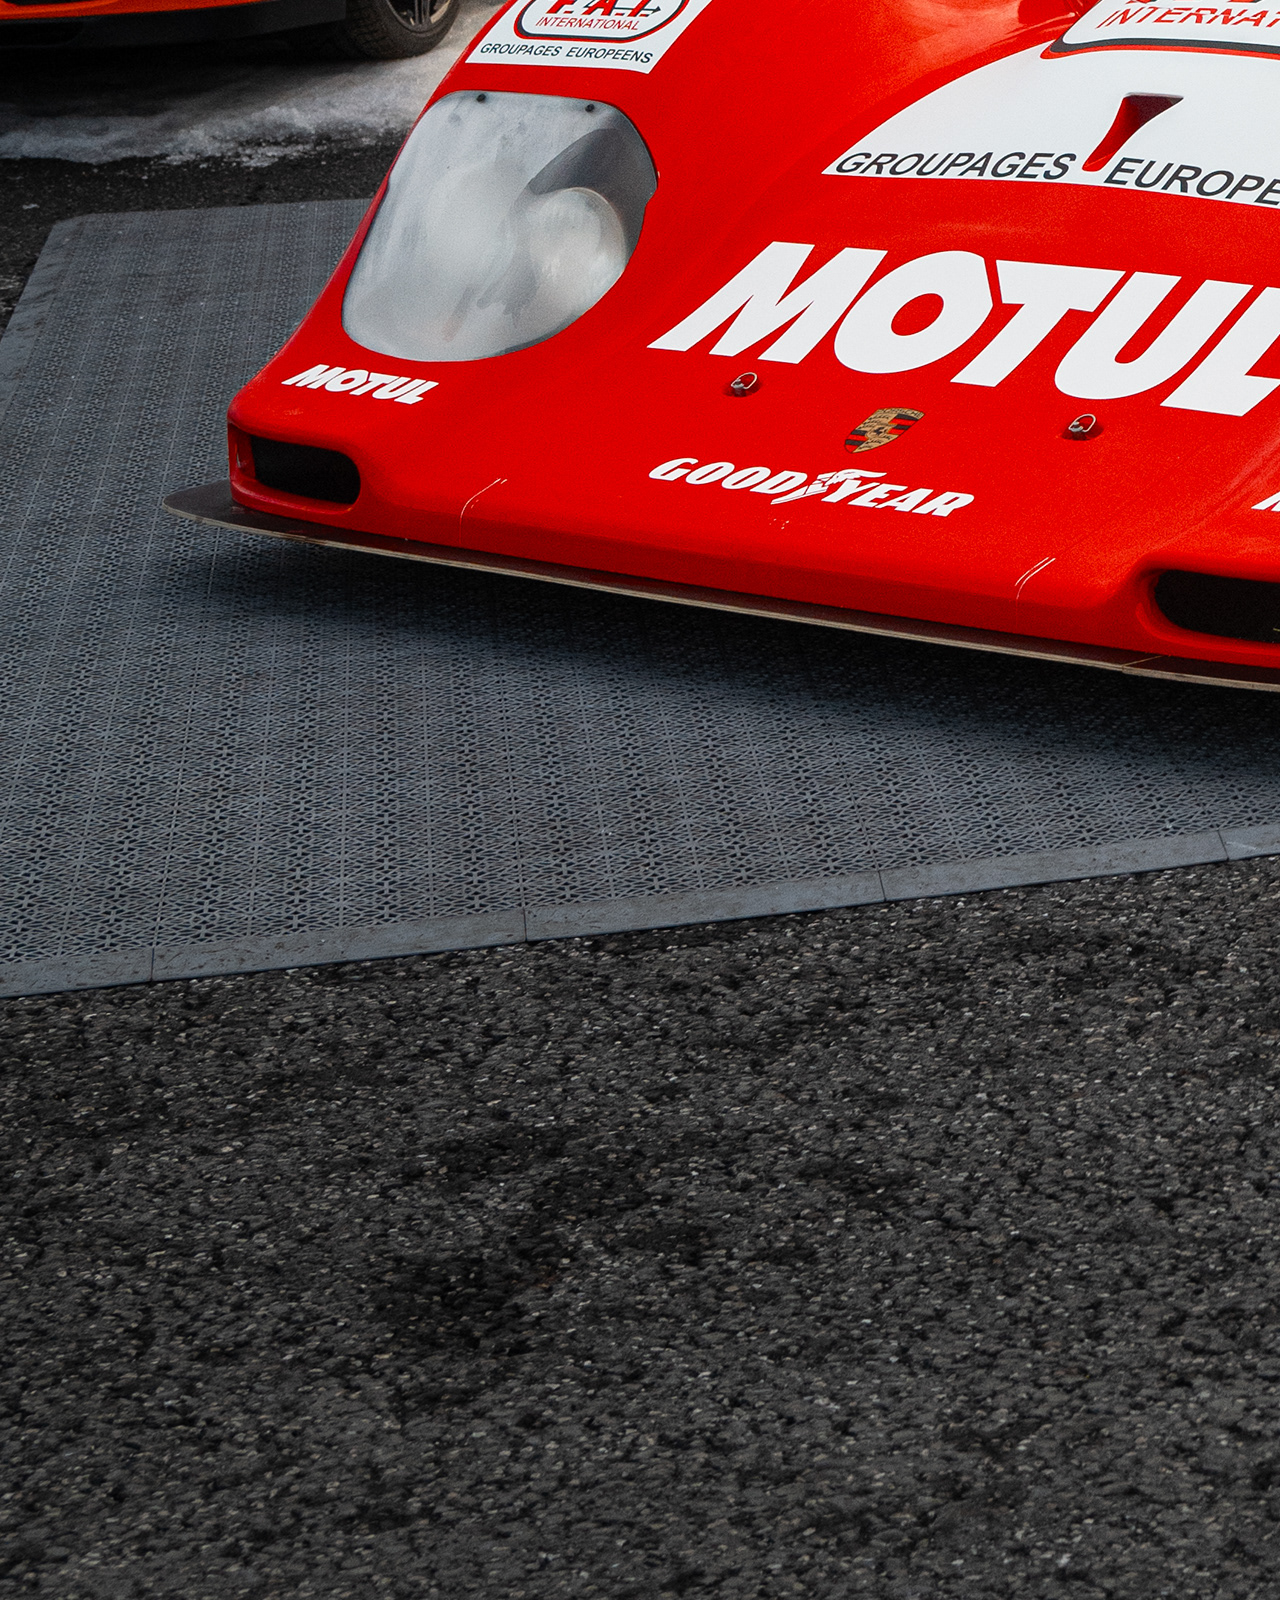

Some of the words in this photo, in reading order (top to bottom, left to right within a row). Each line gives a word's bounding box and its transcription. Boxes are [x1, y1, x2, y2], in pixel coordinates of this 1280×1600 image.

[535, 16, 640, 30] INTERNATIONAL
[480, 43, 562, 57] GROUPAGES
[565, 46, 654, 64] EUROPEENS
[835, 151, 1077, 180] GROUPAGES
[281, 363, 439, 405] MOTUL
[648, 457, 976, 518] GOODYEAR
